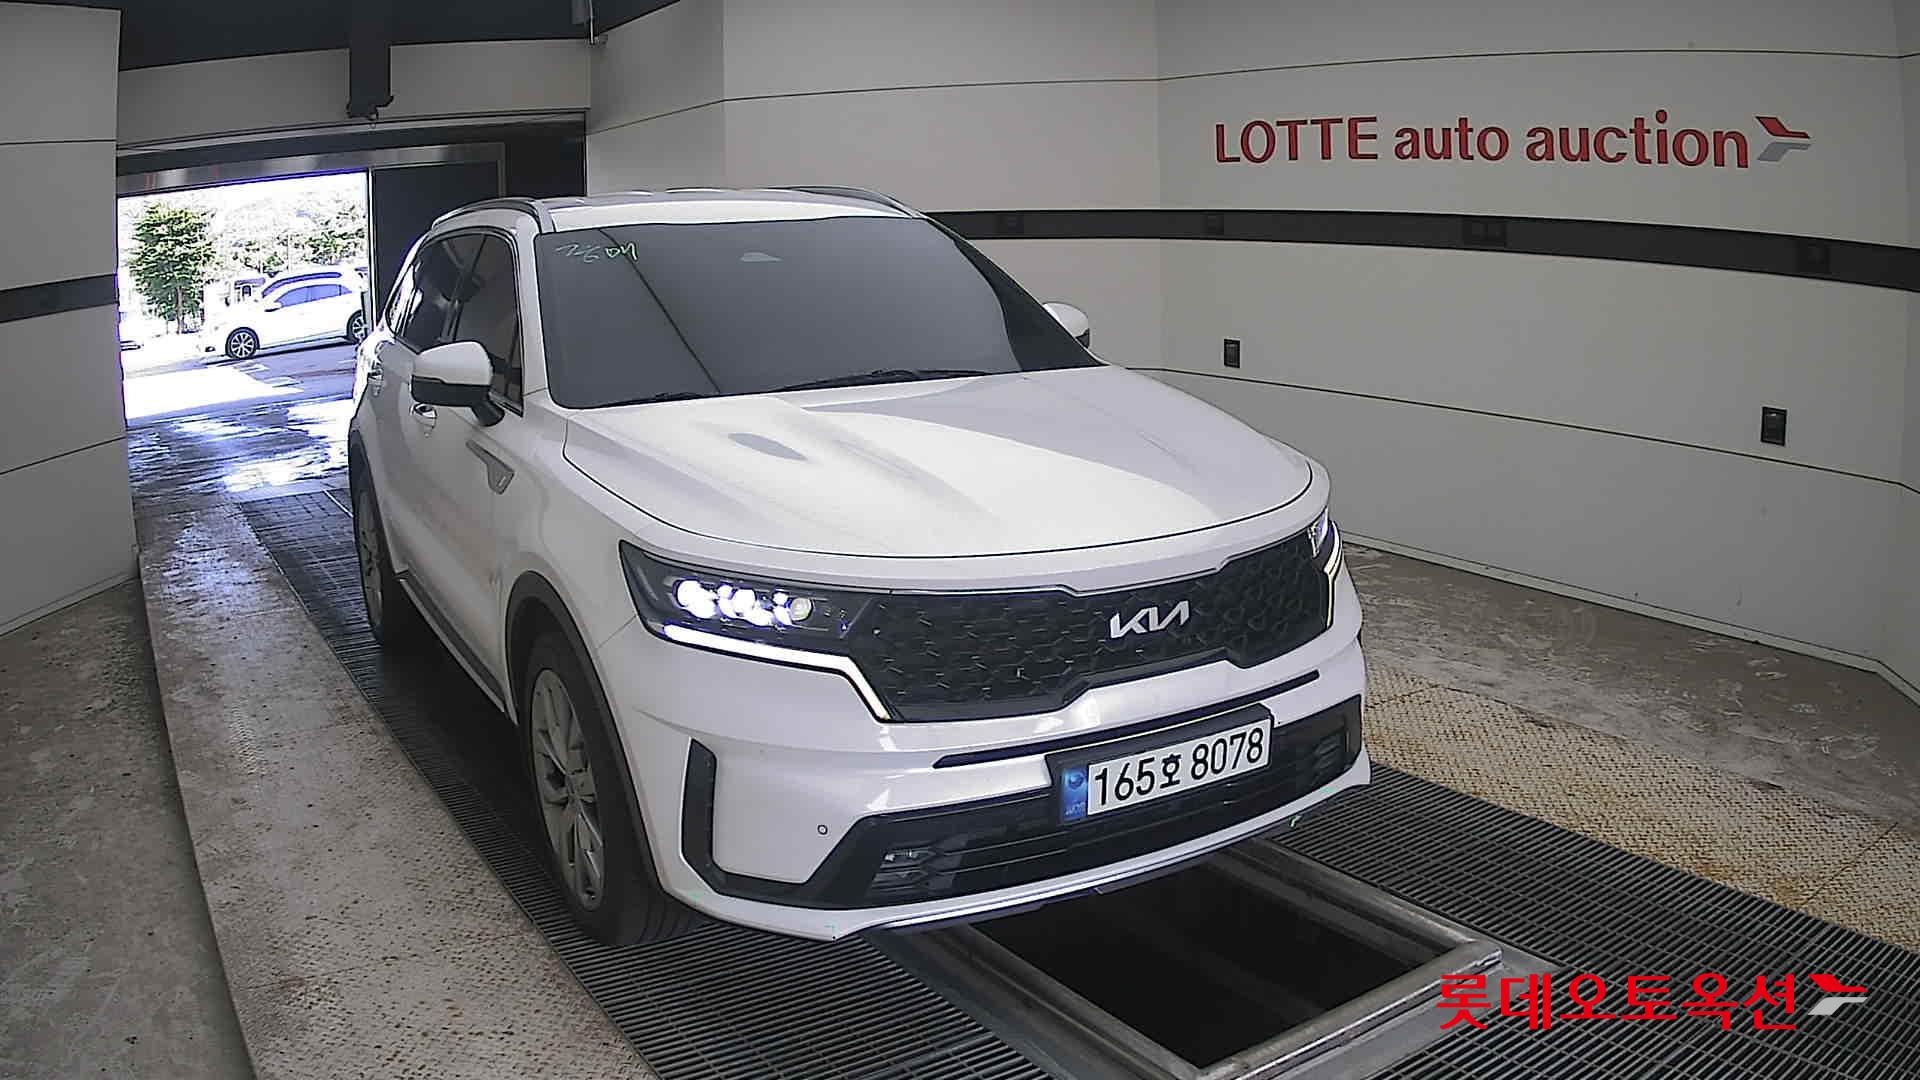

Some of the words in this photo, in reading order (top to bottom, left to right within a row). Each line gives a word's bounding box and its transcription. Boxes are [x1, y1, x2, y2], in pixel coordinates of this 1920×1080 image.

[1215, 116, 1378, 163] LOTTE
[1394, 117, 1509, 161] auto
[1525, 109, 1749, 169] auction
[1110, 600, 1190, 639] KIA
[1094, 754, 1181, 806] 165호
[1191, 727, 1265, 780] 8078
